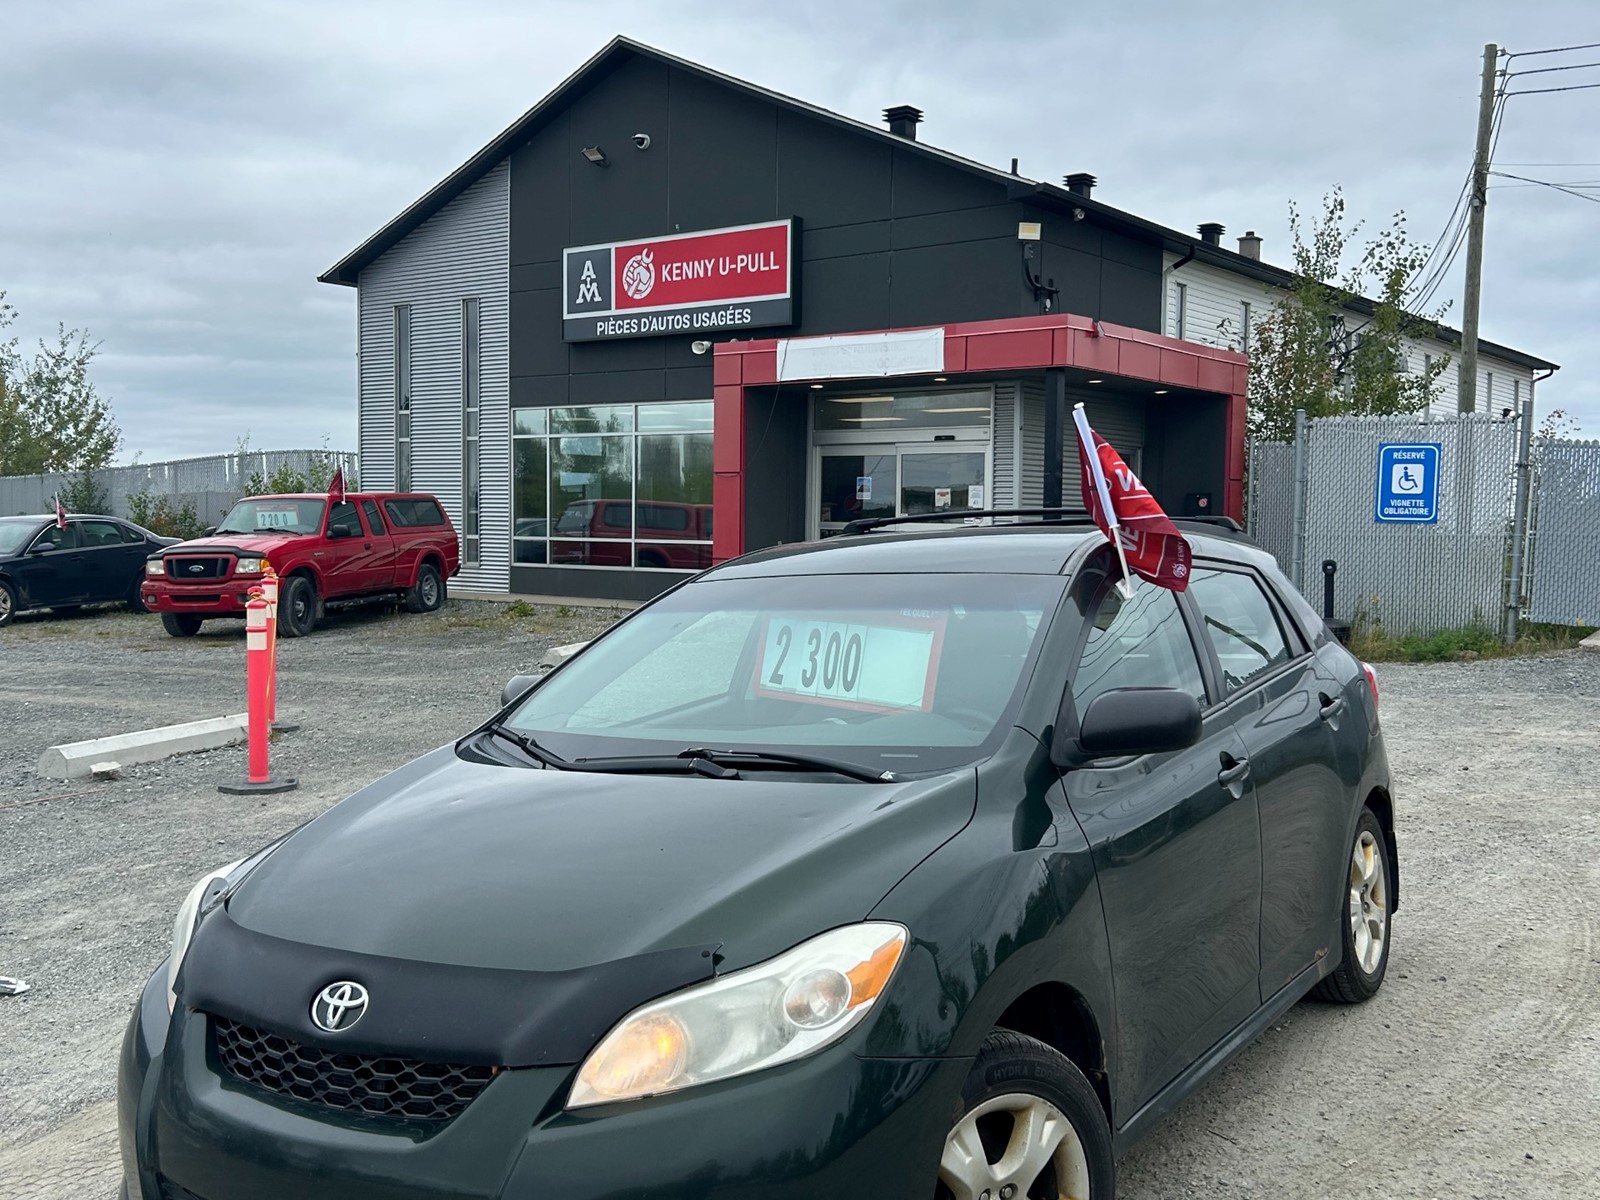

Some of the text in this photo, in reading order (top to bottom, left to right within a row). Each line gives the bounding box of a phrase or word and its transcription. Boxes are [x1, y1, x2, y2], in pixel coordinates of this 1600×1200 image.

[661, 251, 780, 282] KENNY U-PULL
[597, 306, 751, 336] PIÈCES D'AUTOS USAGÉES
[1392, 450, 1426, 460] RÉSERVÉ
[1383, 507, 1430, 515] OBLIGATOIRE
[1390, 499, 1425, 507] VIGNETTE
[1177, 541, 1185, 562] KENNY
[993, 1065, 1028, 1081] HYDRA
